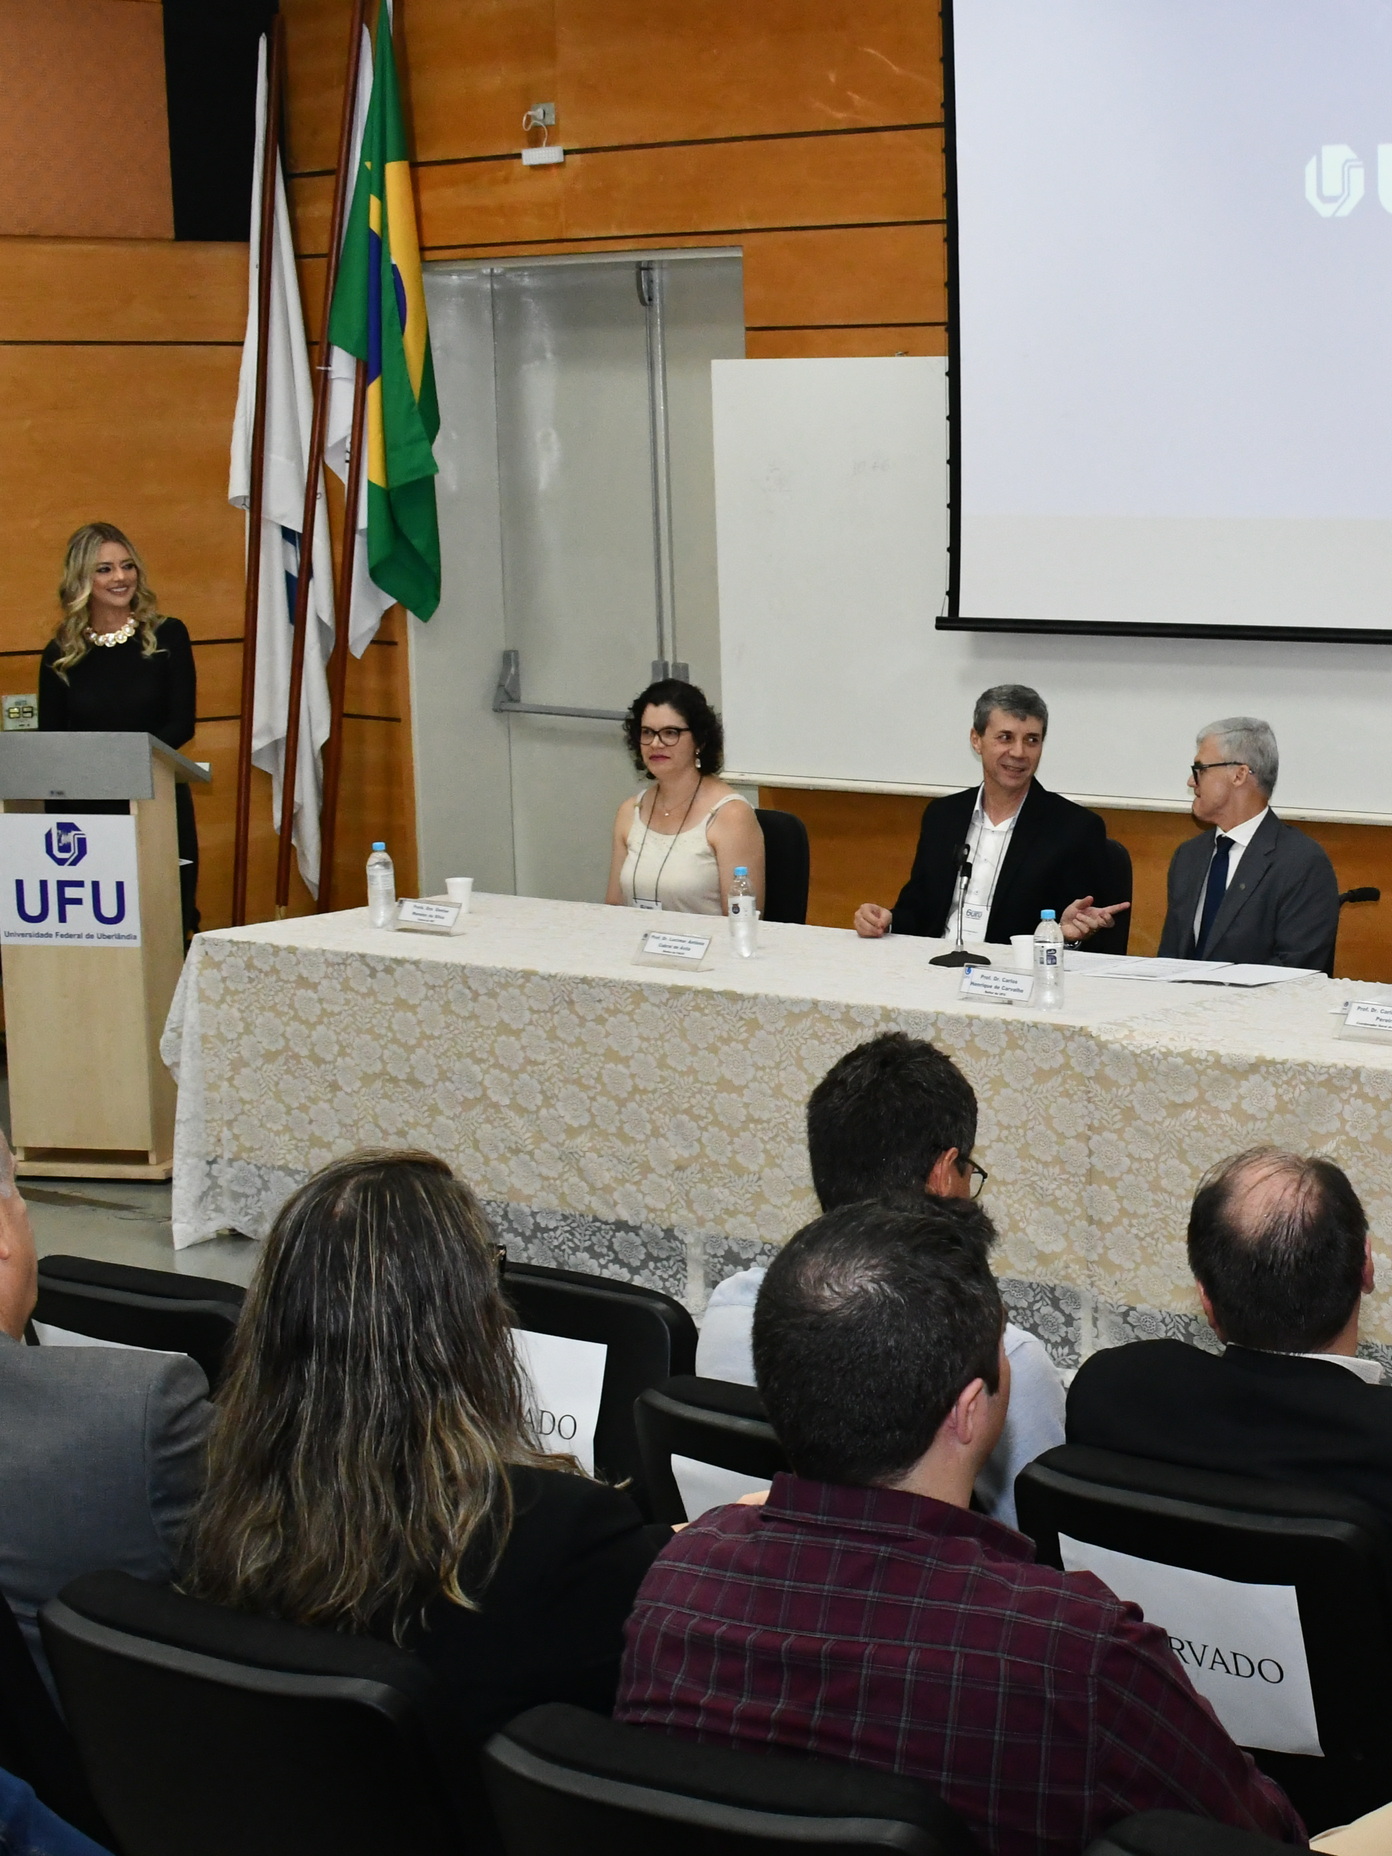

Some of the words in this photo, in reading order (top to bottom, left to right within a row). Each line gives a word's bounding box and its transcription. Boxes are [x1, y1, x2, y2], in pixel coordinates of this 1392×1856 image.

[15, 879, 126, 925] UFU
[55, 931, 83, 939] Federal
[97, 932, 137, 940] Uberlândia
[523, 1408, 577, 1440] ADO
[1168, 1636, 1285, 1684] RVADO
